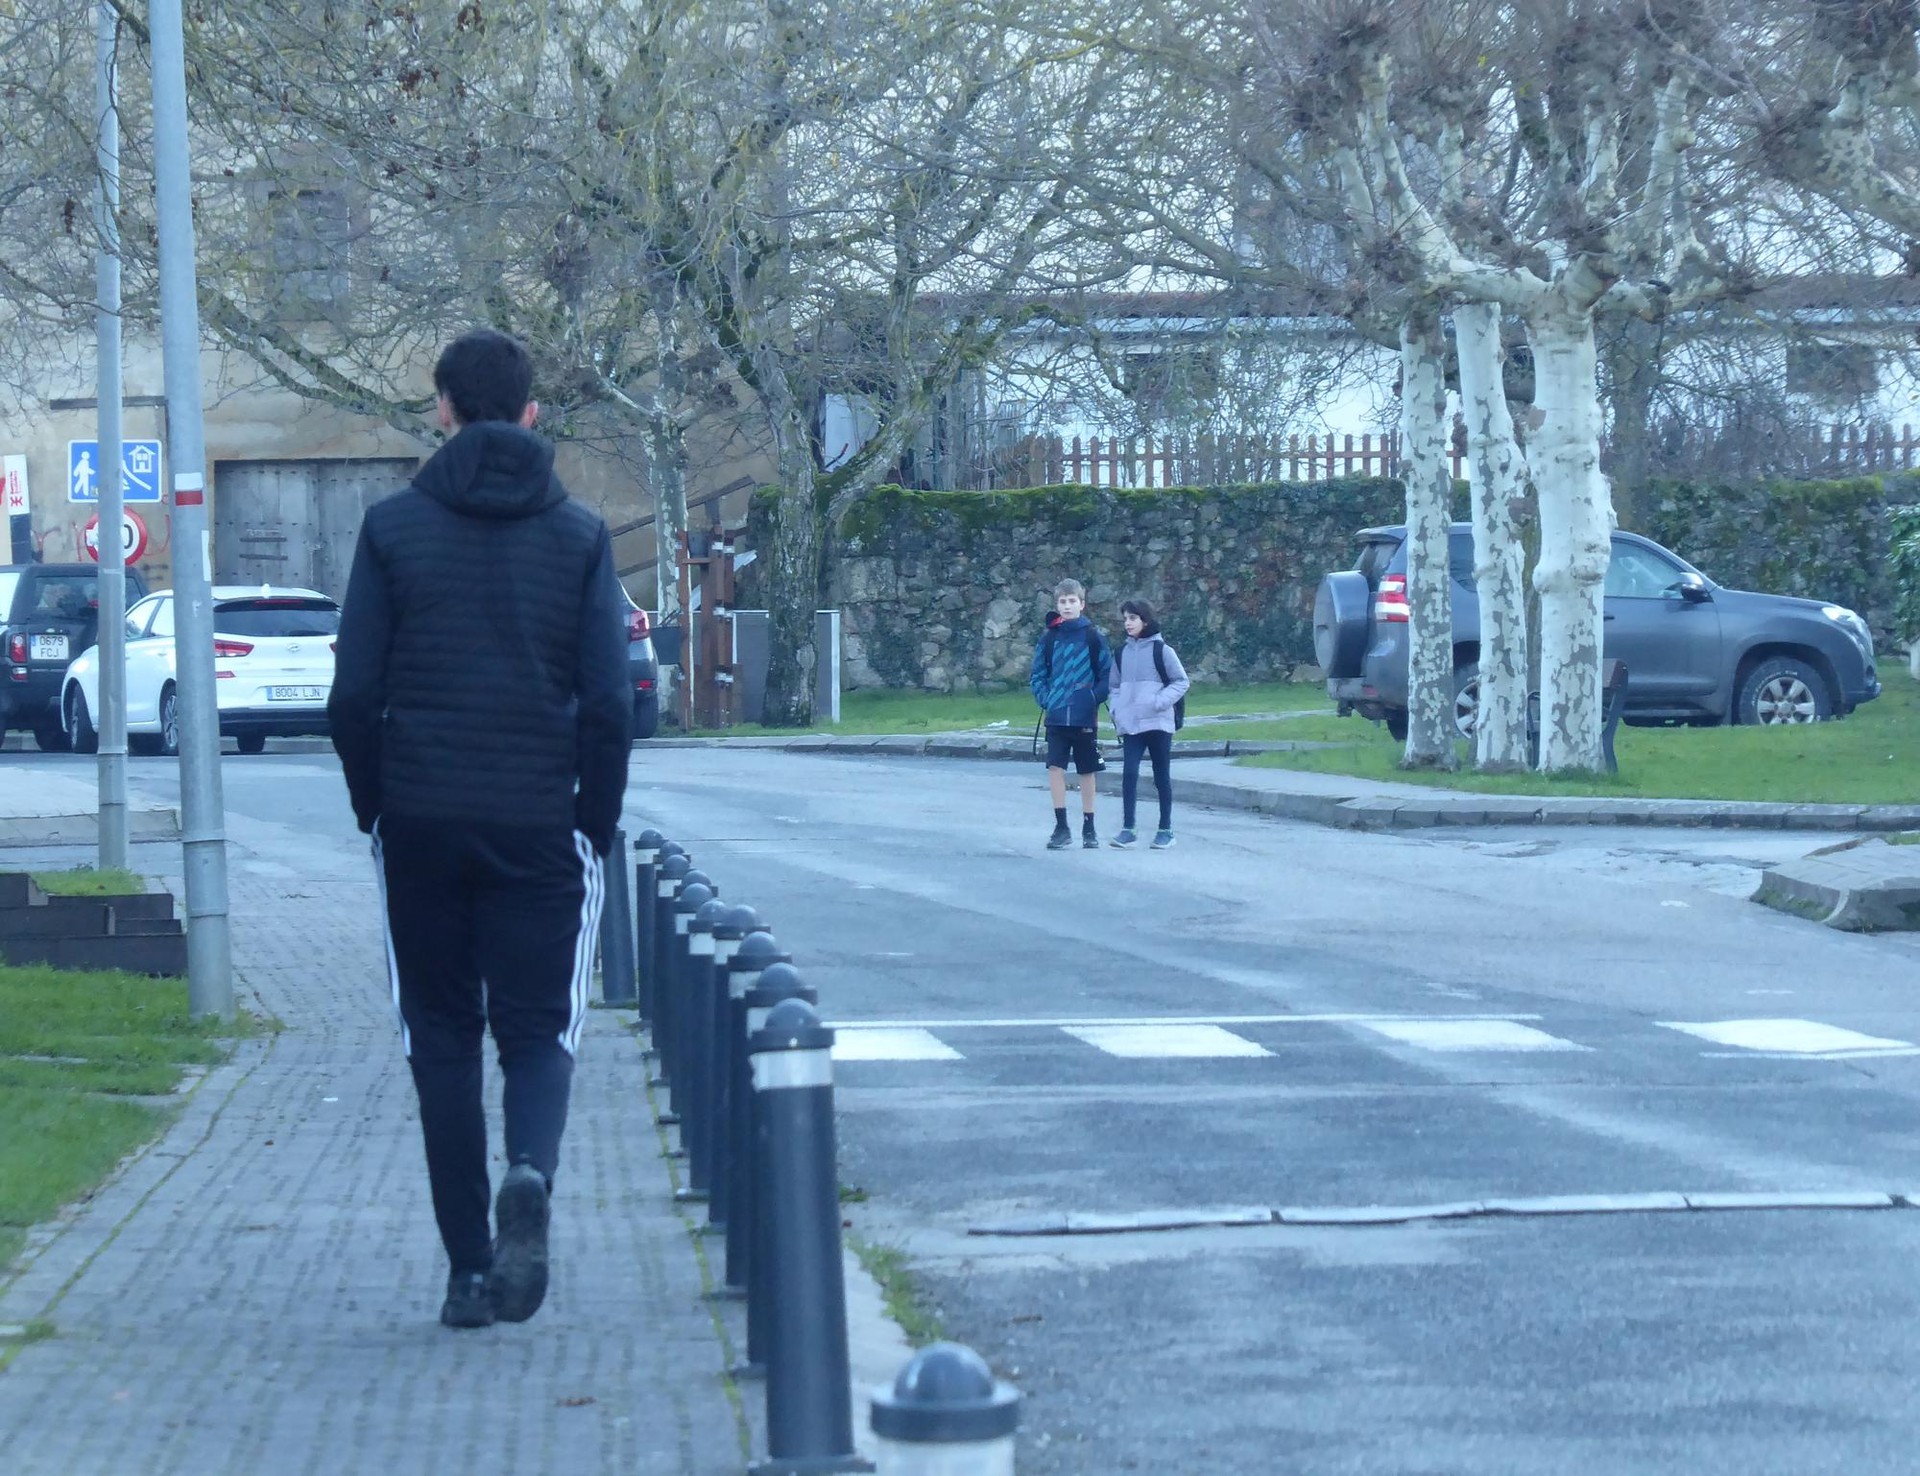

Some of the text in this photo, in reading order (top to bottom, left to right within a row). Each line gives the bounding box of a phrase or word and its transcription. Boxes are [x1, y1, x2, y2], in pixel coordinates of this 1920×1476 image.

[40, 635, 64, 646] 0679
[40, 647, 59, 658] FCJ
[275, 687, 321, 698] 8004 LJN
